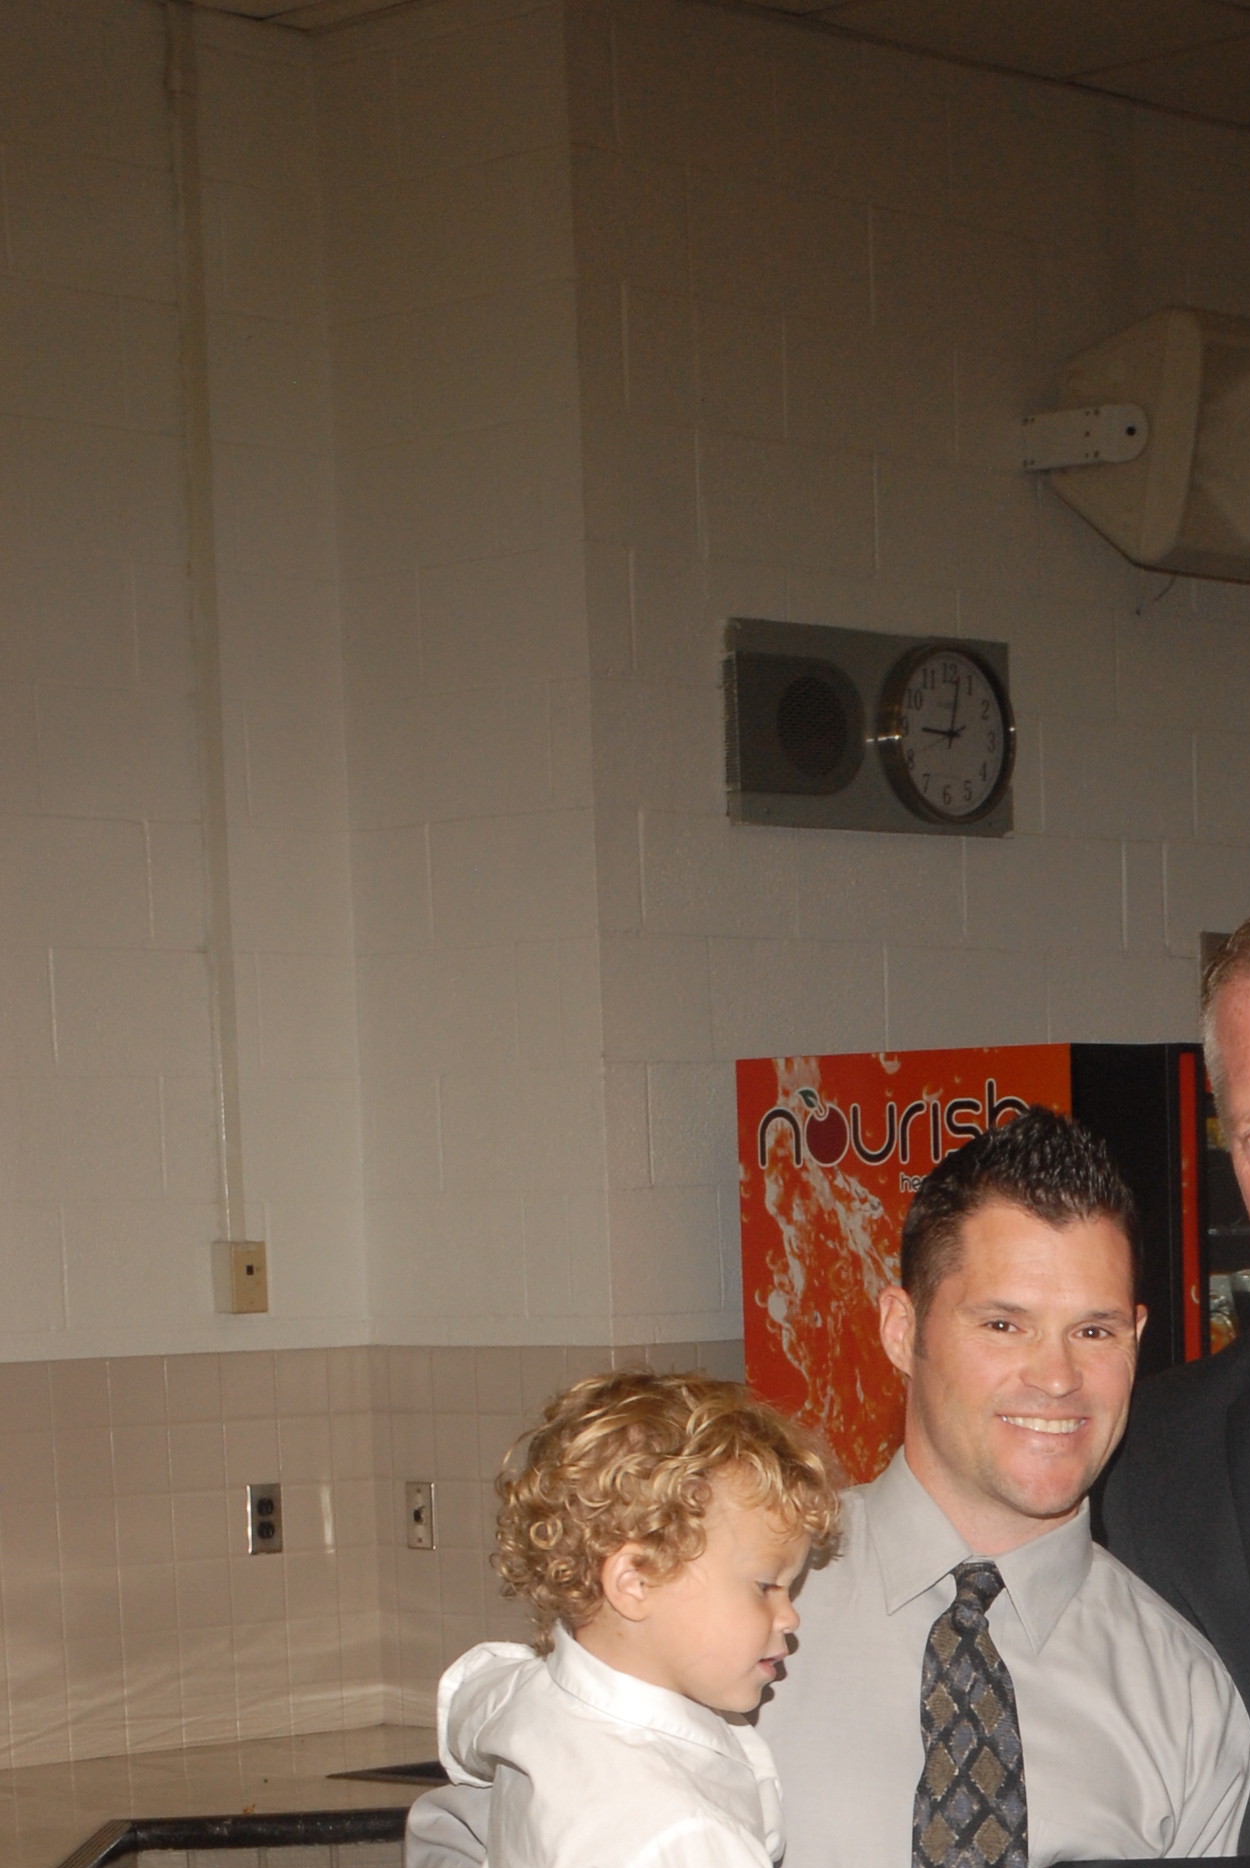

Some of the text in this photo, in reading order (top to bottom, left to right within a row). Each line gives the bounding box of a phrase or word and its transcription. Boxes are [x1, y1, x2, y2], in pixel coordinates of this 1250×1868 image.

[922, 668, 935, 690] 11
[942, 663, 958, 685] 12
[966, 675, 973, 696] 1
[907, 688, 923, 711] 10
[981, 699, 991, 720] 2
[987, 731, 996, 753] 3
[906, 748, 915, 770] 8
[922, 773, 931, 793] 7
[979, 763, 987, 782] 4
[942, 785, 952, 805] 6
[964, 780, 972, 801] 5
